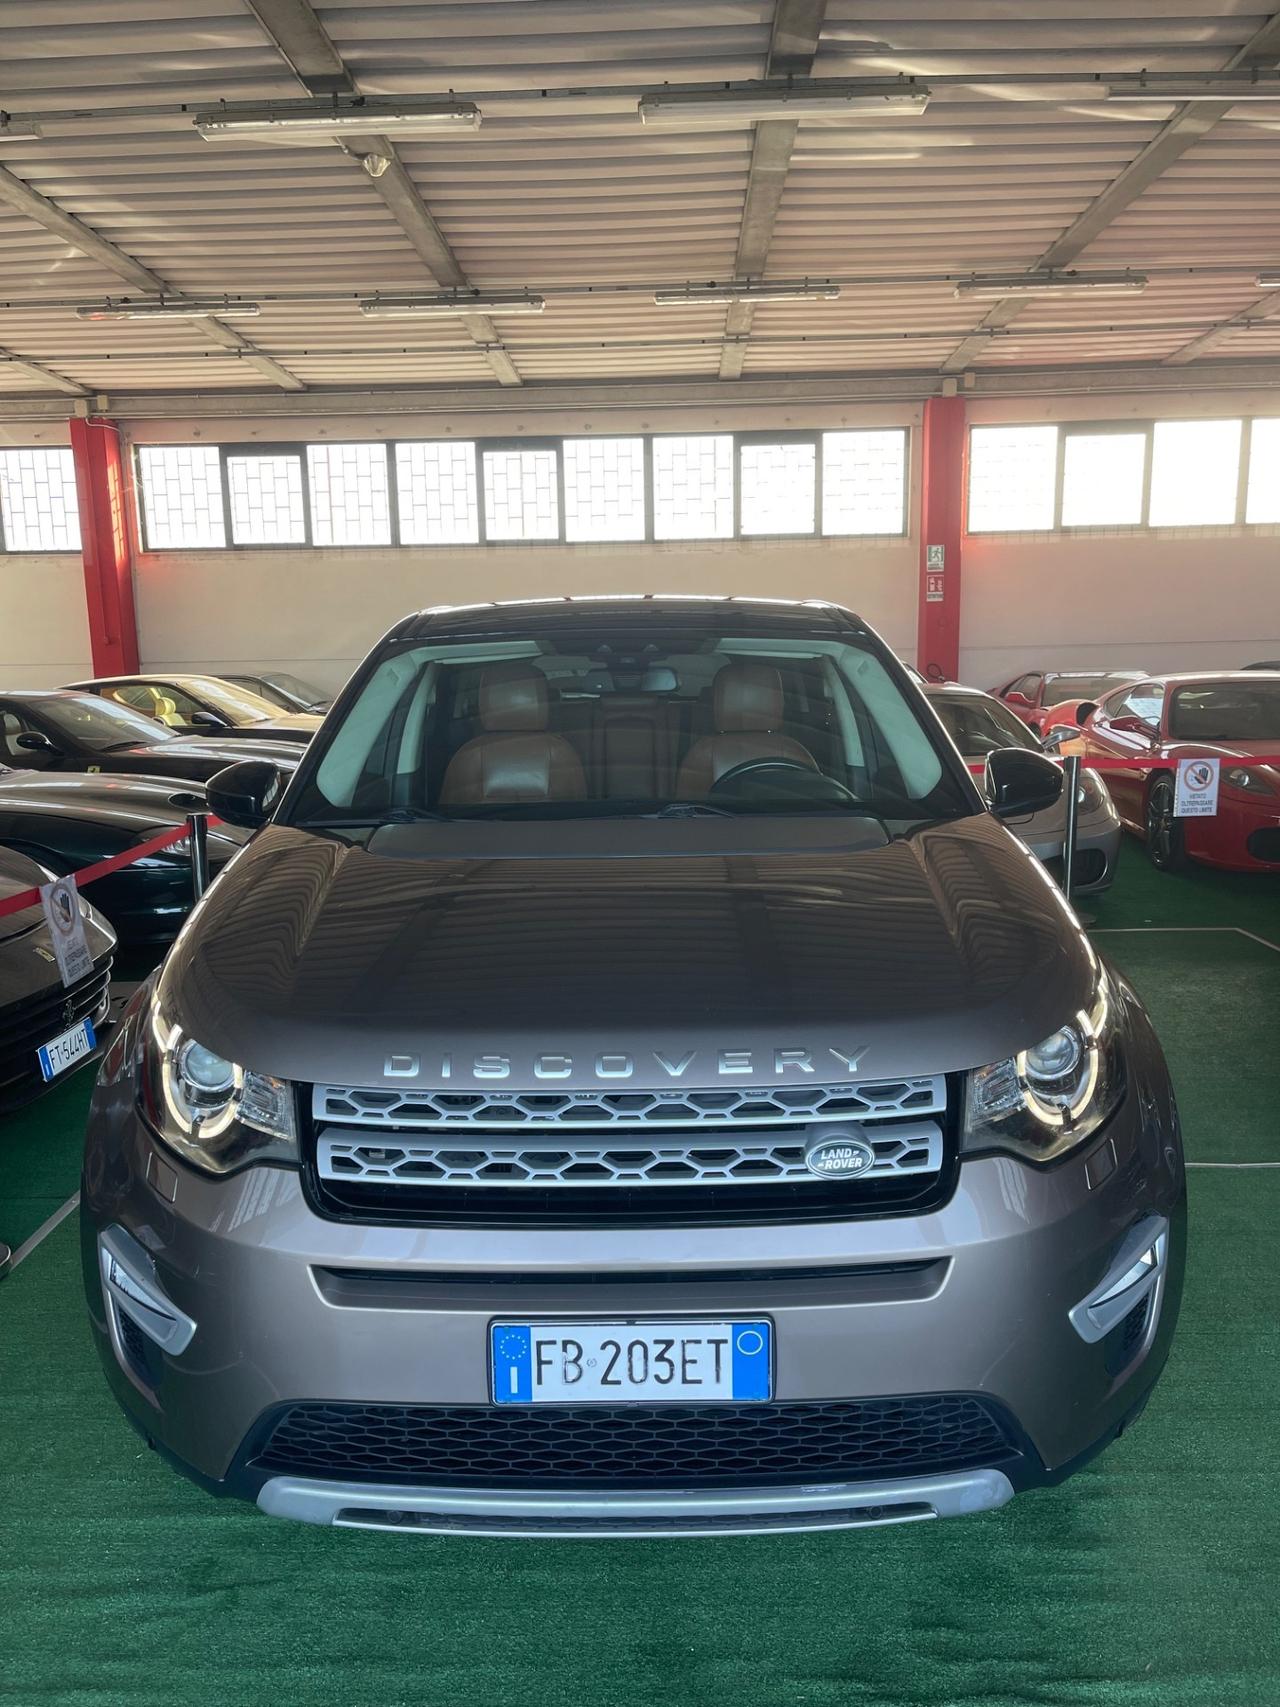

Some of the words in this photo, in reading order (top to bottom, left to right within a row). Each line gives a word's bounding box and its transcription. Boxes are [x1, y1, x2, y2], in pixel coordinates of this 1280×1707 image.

[383, 1045, 870, 1079] DISCOVERY
[821, 1148, 852, 1160] LAND
[824, 1158, 863, 1170] ROVER
[535, 1339, 584, 1385] FB
[600, 1338, 729, 1385] 203ET
